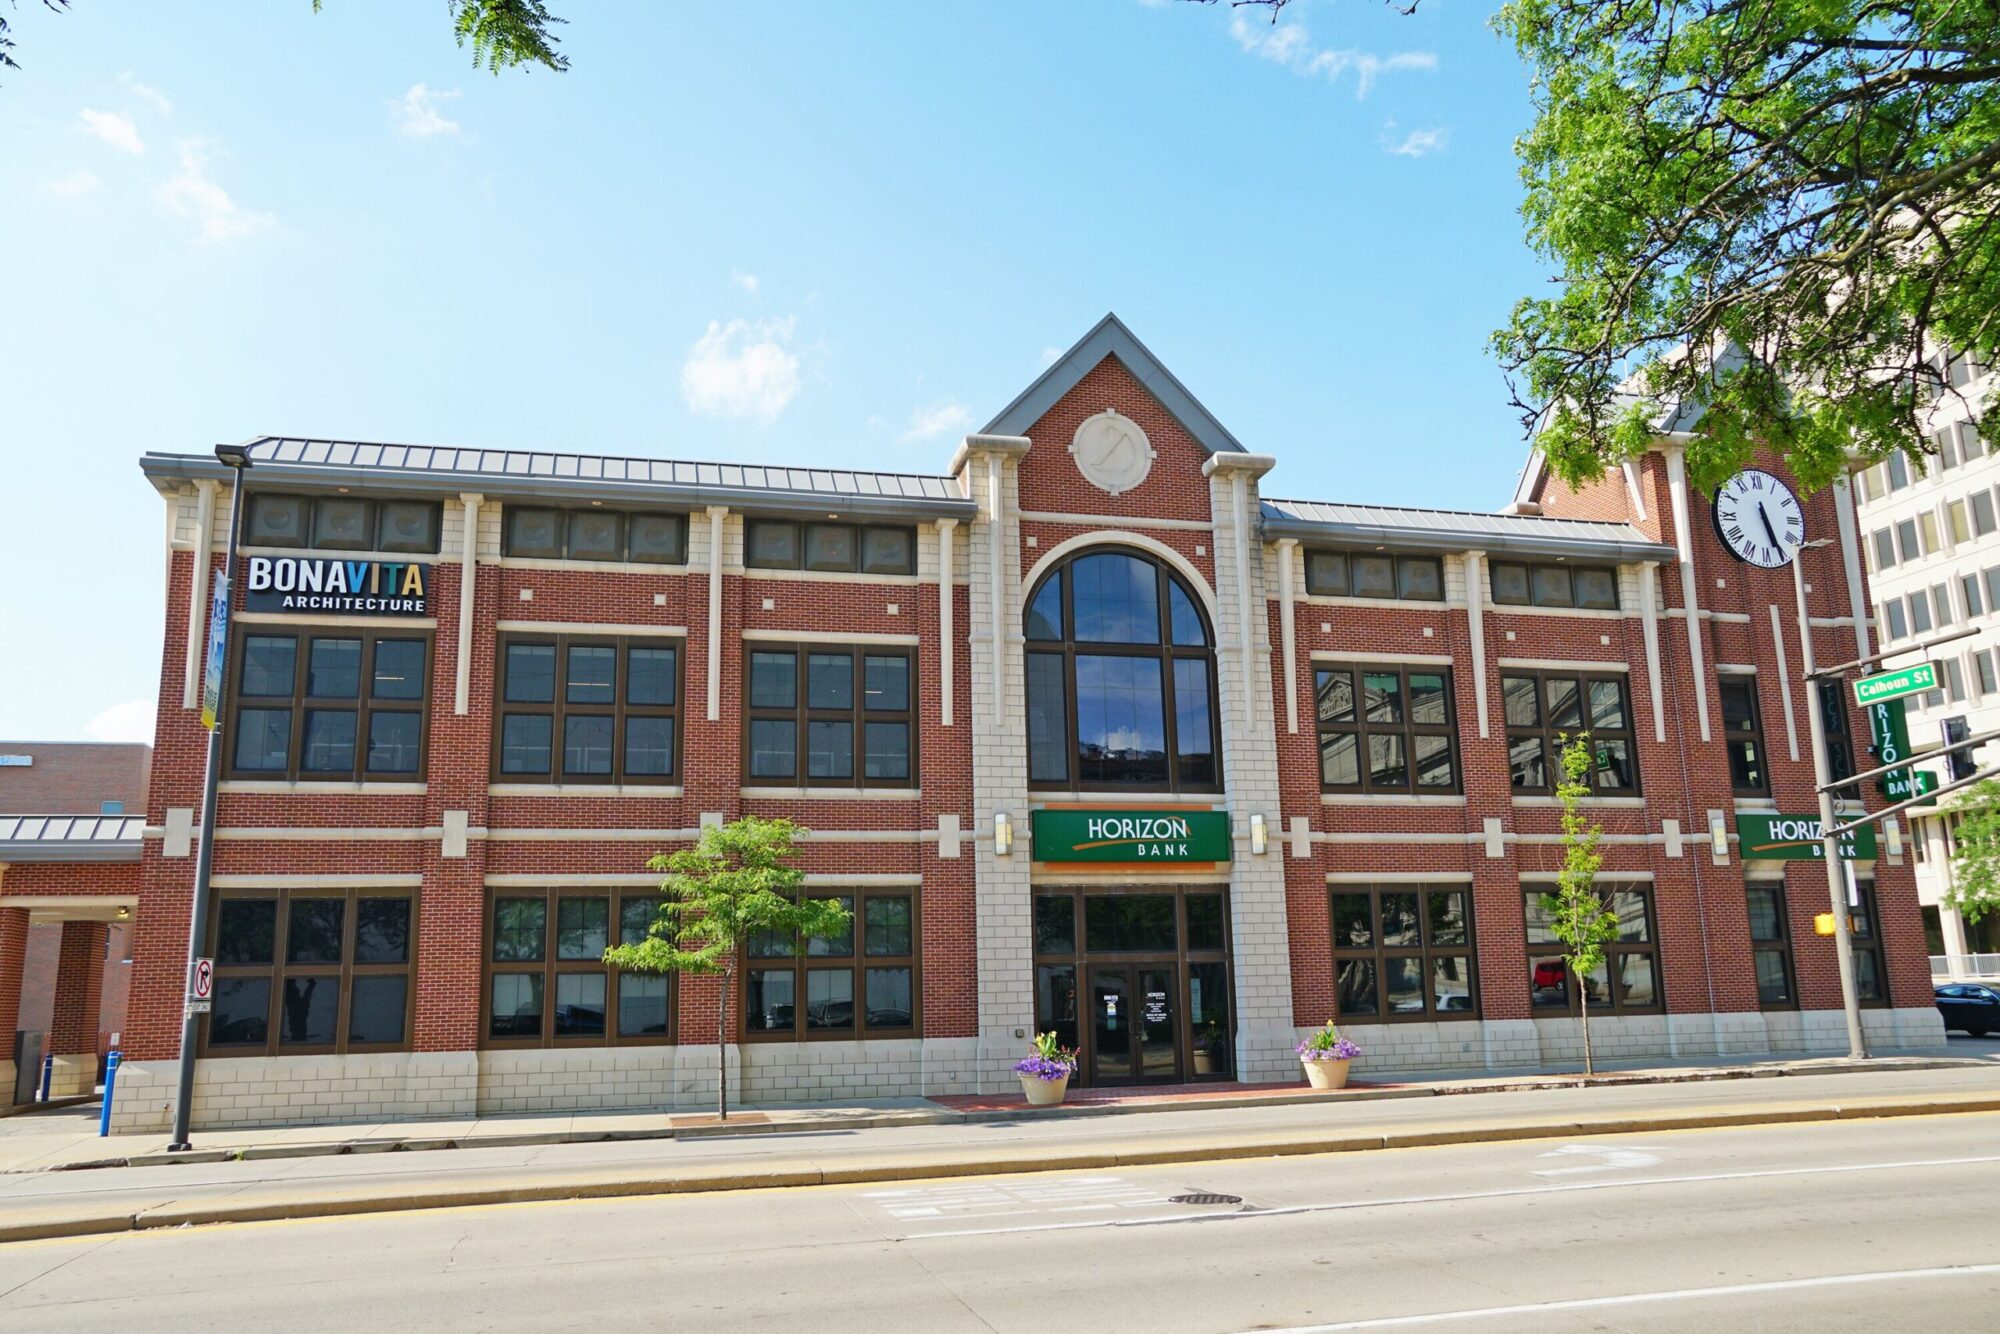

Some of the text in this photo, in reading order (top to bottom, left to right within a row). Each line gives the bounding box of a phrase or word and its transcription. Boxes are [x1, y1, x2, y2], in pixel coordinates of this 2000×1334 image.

[248, 557, 425, 597] BONAVITA
[282, 595, 426, 613] ARCHITECTURE
[1859, 669, 1930, 697] Calhoun St
[1877, 703, 1898, 779] RIZON
[1088, 818, 1188, 839] HORIZON
[1768, 820, 1856, 840] HORIZN
[1138, 844, 1188, 856] BANK
[1812, 845, 1857, 856] BNK
